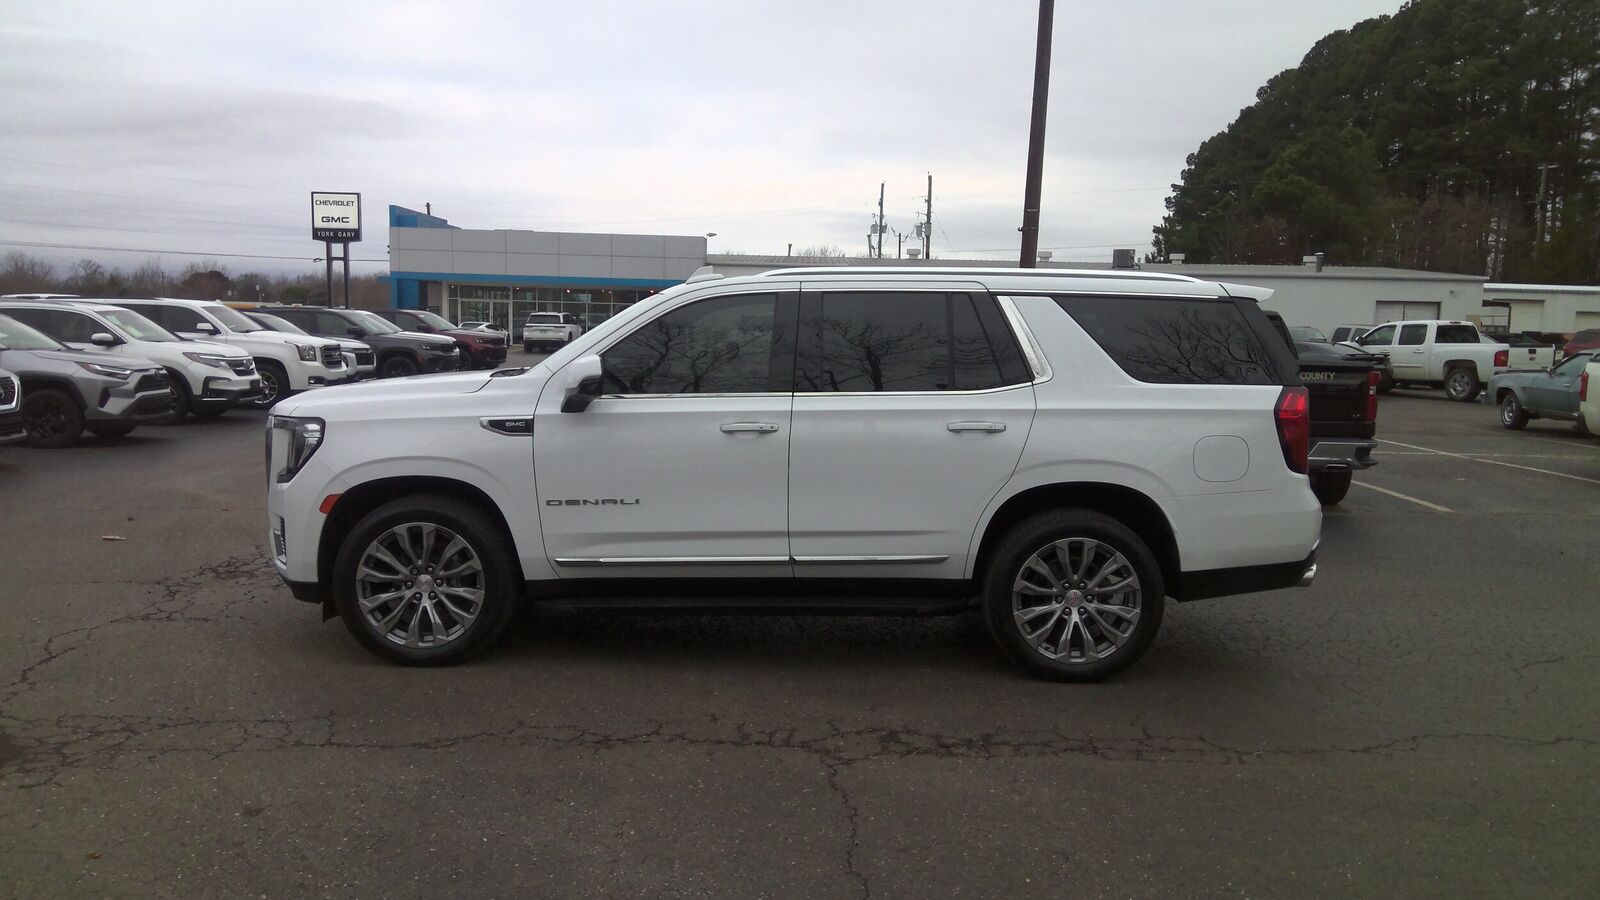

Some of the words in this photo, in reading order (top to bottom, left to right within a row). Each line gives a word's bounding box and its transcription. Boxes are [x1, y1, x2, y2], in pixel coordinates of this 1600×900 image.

[315, 199, 355, 207] CHEVROLET
[321, 216, 350, 224] GMC
[1300, 371, 1336, 380] COUNTY
[545, 498, 640, 506] DENALI
